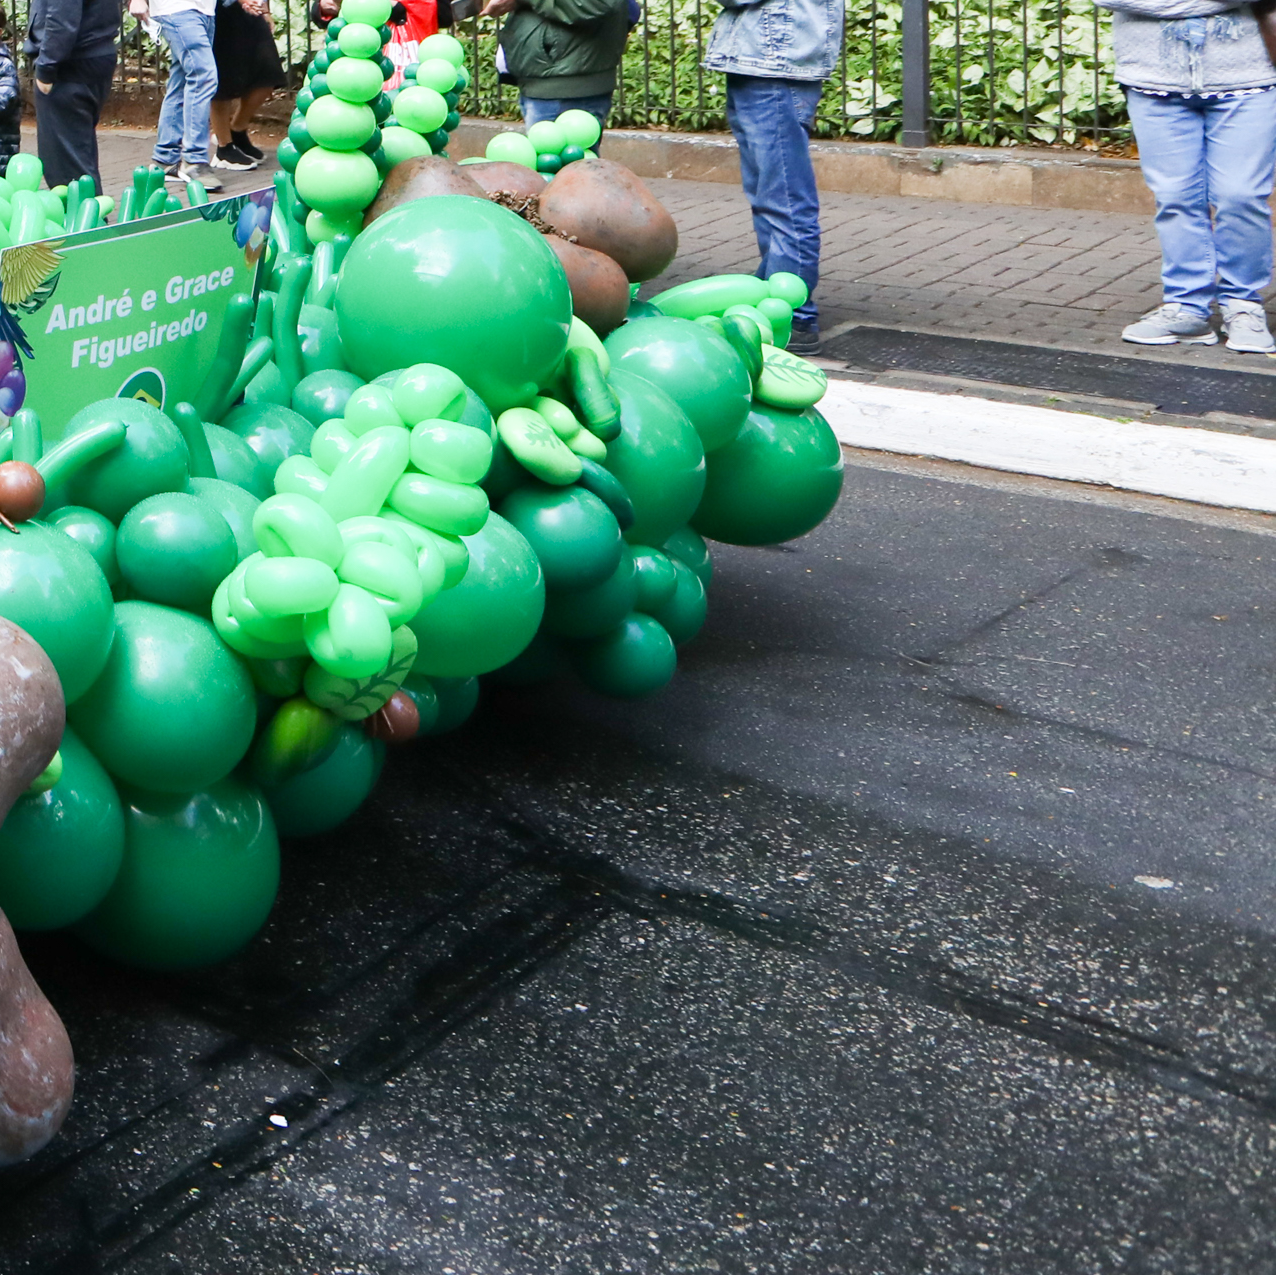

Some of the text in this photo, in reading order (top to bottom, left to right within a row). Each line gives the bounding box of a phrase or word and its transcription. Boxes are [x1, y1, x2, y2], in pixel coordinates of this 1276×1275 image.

[45, 266, 234, 334] André e Grace
[71, 309, 208, 369] Figueiredo
